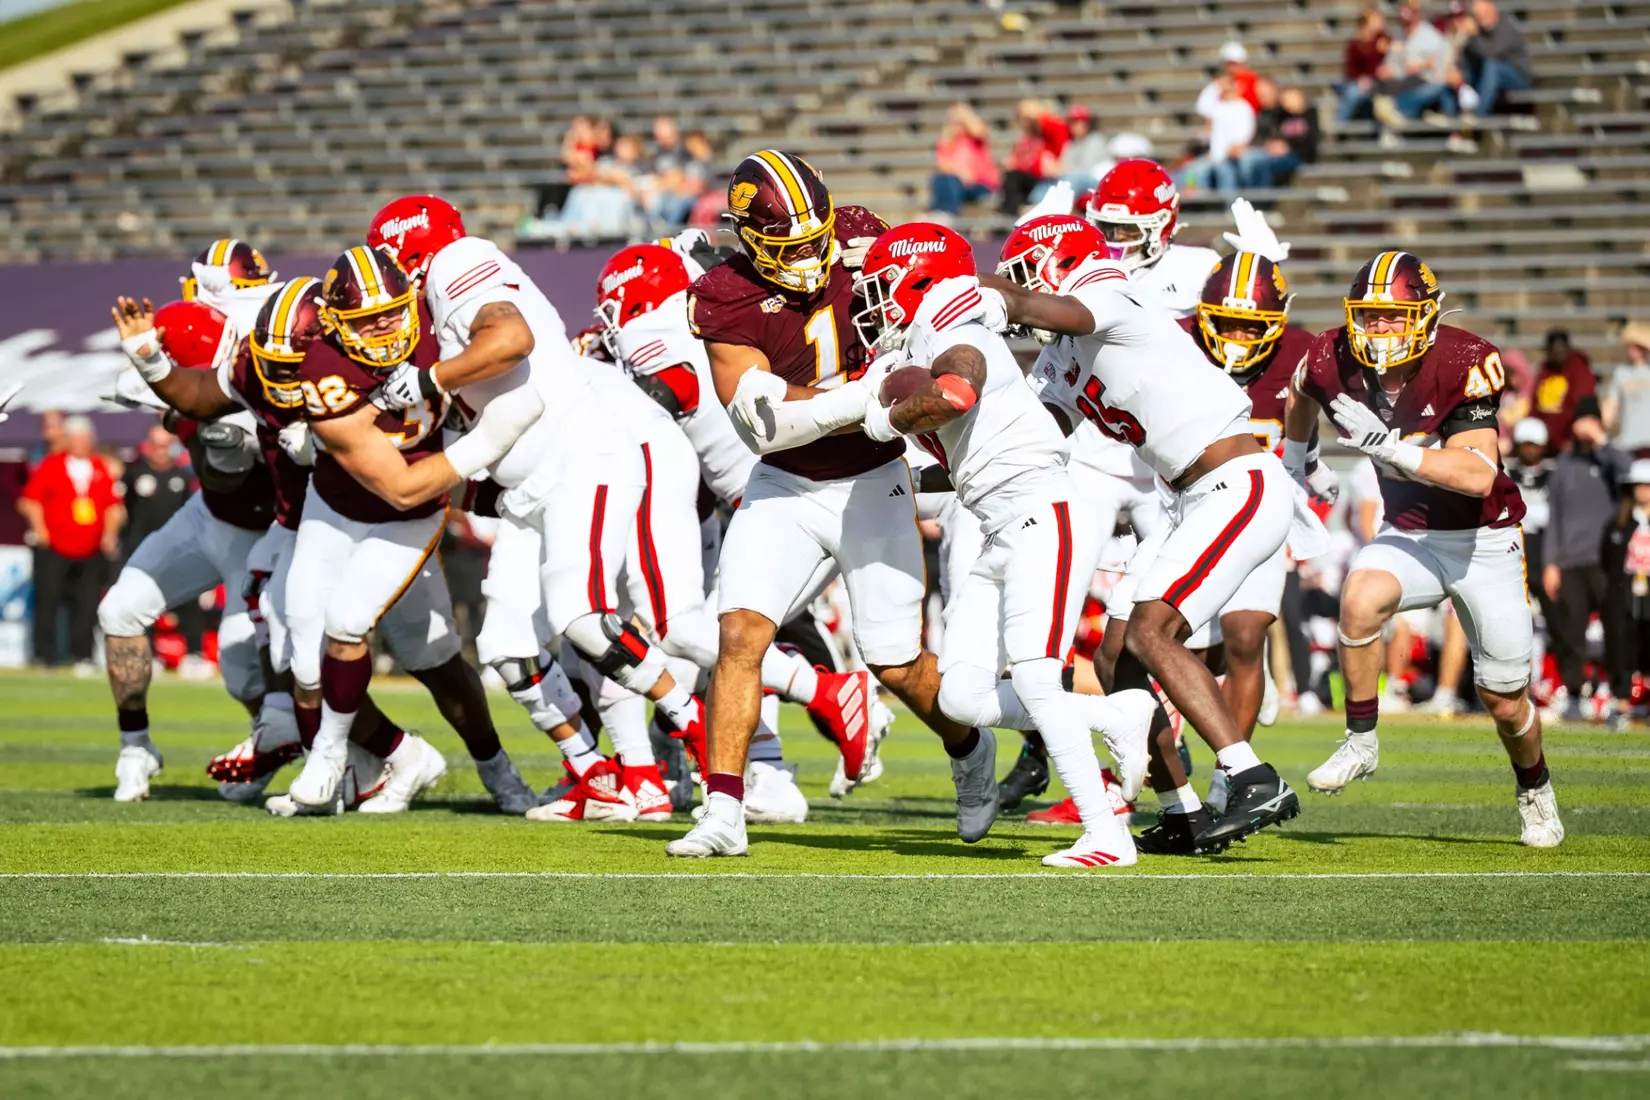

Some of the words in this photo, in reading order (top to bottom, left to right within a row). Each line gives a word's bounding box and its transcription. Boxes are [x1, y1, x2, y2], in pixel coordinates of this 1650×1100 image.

[380, 208, 429, 240] Miami
[1029, 221, 1084, 242] Miami
[888, 237, 946, 258] Miami
[602, 259, 644, 295] Miami
[803, 304, 848, 390] 1
[1464, 351, 1505, 398] 40
